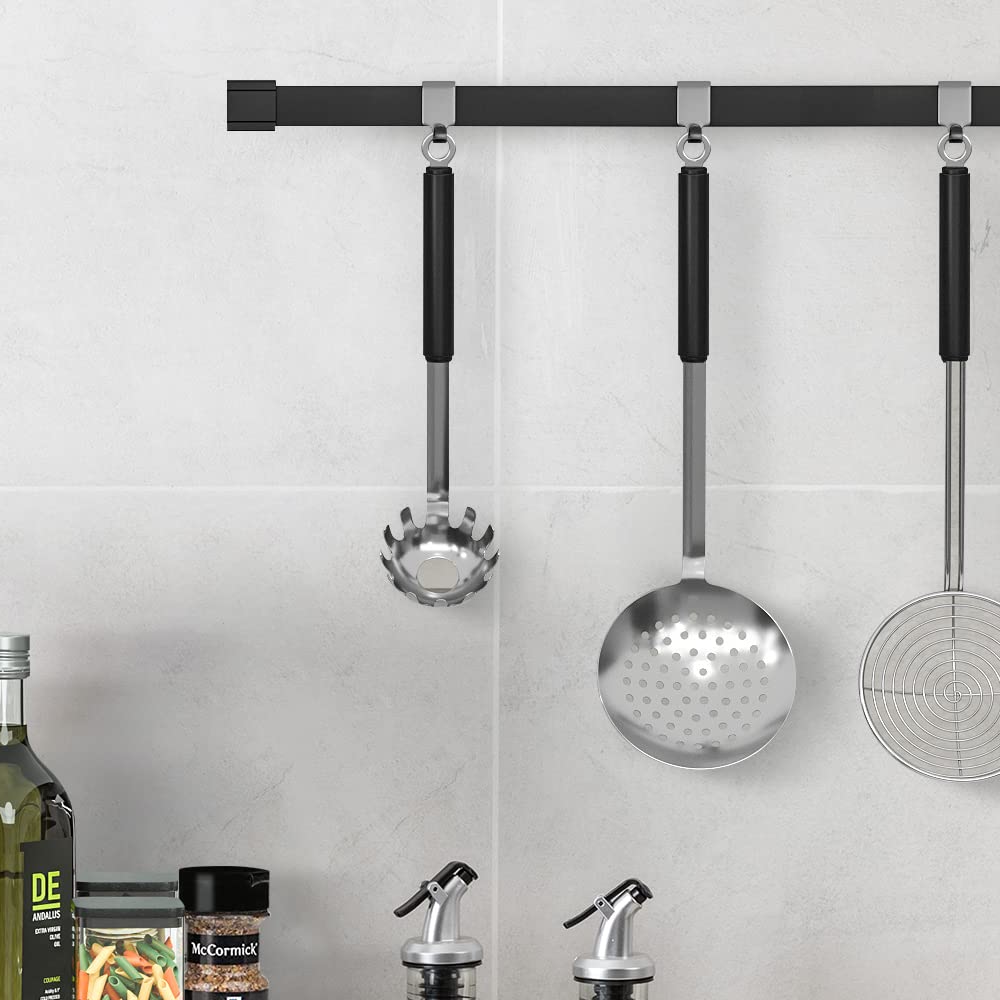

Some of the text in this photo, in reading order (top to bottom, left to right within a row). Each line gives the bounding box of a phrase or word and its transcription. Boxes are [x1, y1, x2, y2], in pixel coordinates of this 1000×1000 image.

[32, 870, 61, 903] DE
[32, 910, 61, 921] ANDALUS
[191, 941, 258, 956] McCormick
